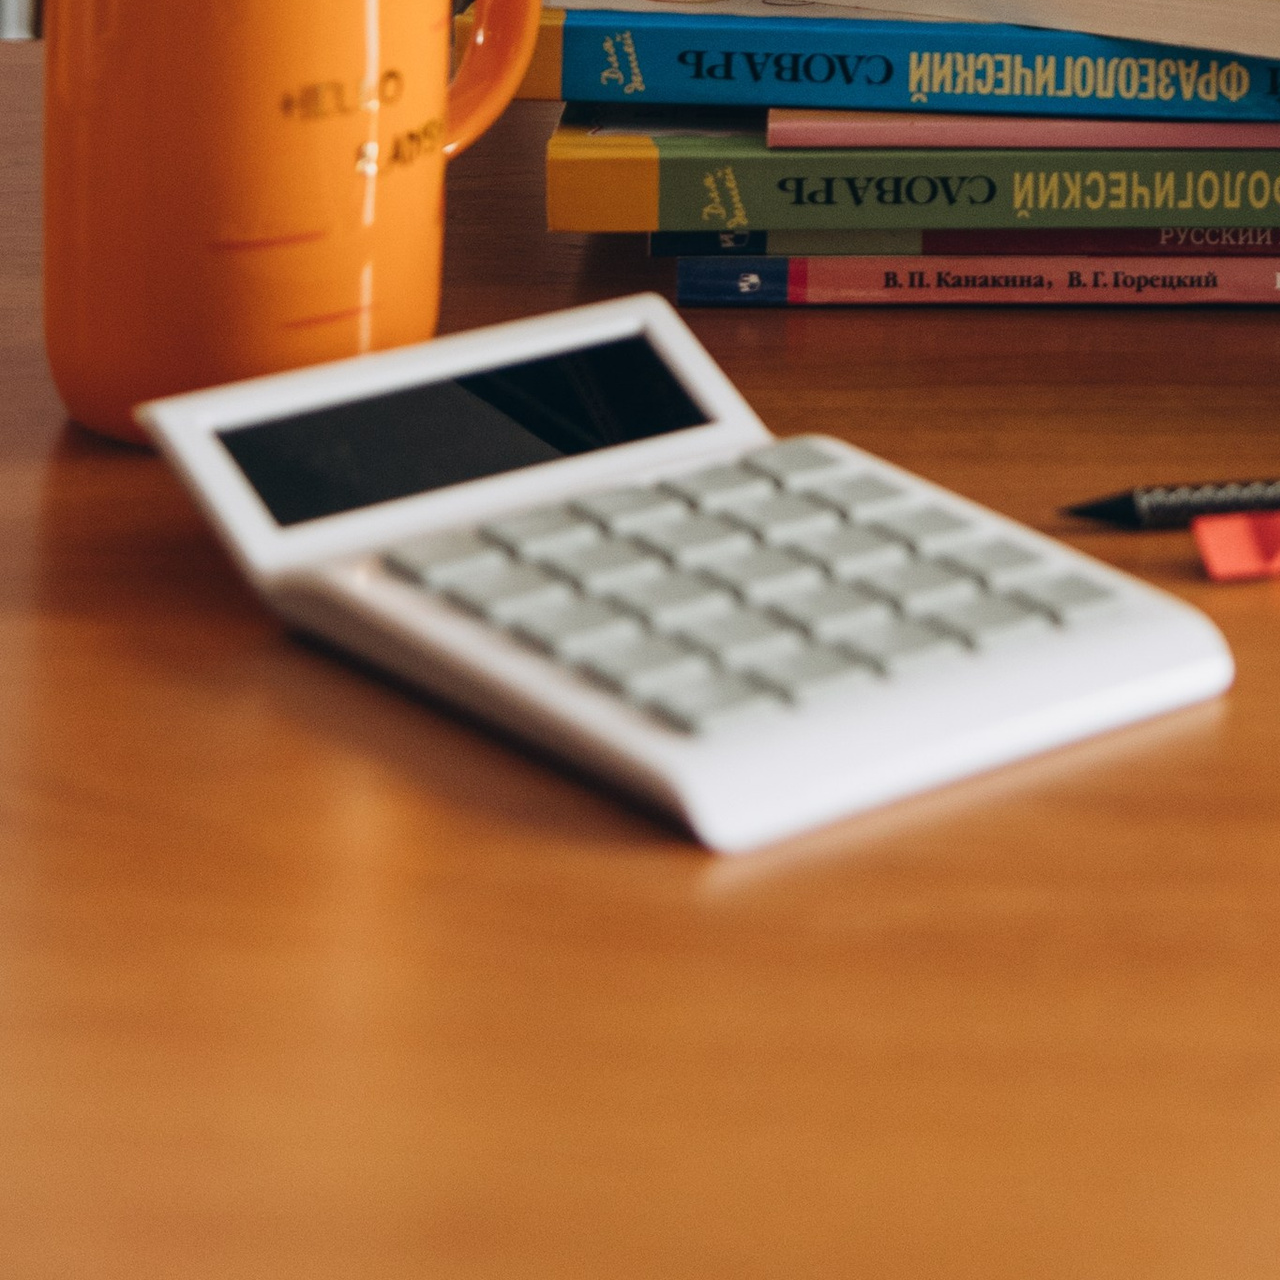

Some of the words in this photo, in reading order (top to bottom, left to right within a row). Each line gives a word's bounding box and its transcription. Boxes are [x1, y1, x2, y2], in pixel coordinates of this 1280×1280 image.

[678, 50, 895, 86] СЛОВАРЬ
[908, 50, 1250, 103] ФРАЗЕОЛОГИЧЕСКИЙ
[777, 174, 997, 207] СЛОВАРЬ
[883, 270, 904, 290] В.
[907, 270, 931, 290] П.
[936, 270, 1054, 293] Канакина,
[1067, 271, 1088, 290] В.
[1091, 271, 1109, 291] Г.
[1112, 270, 1219, 293] Горецкий
